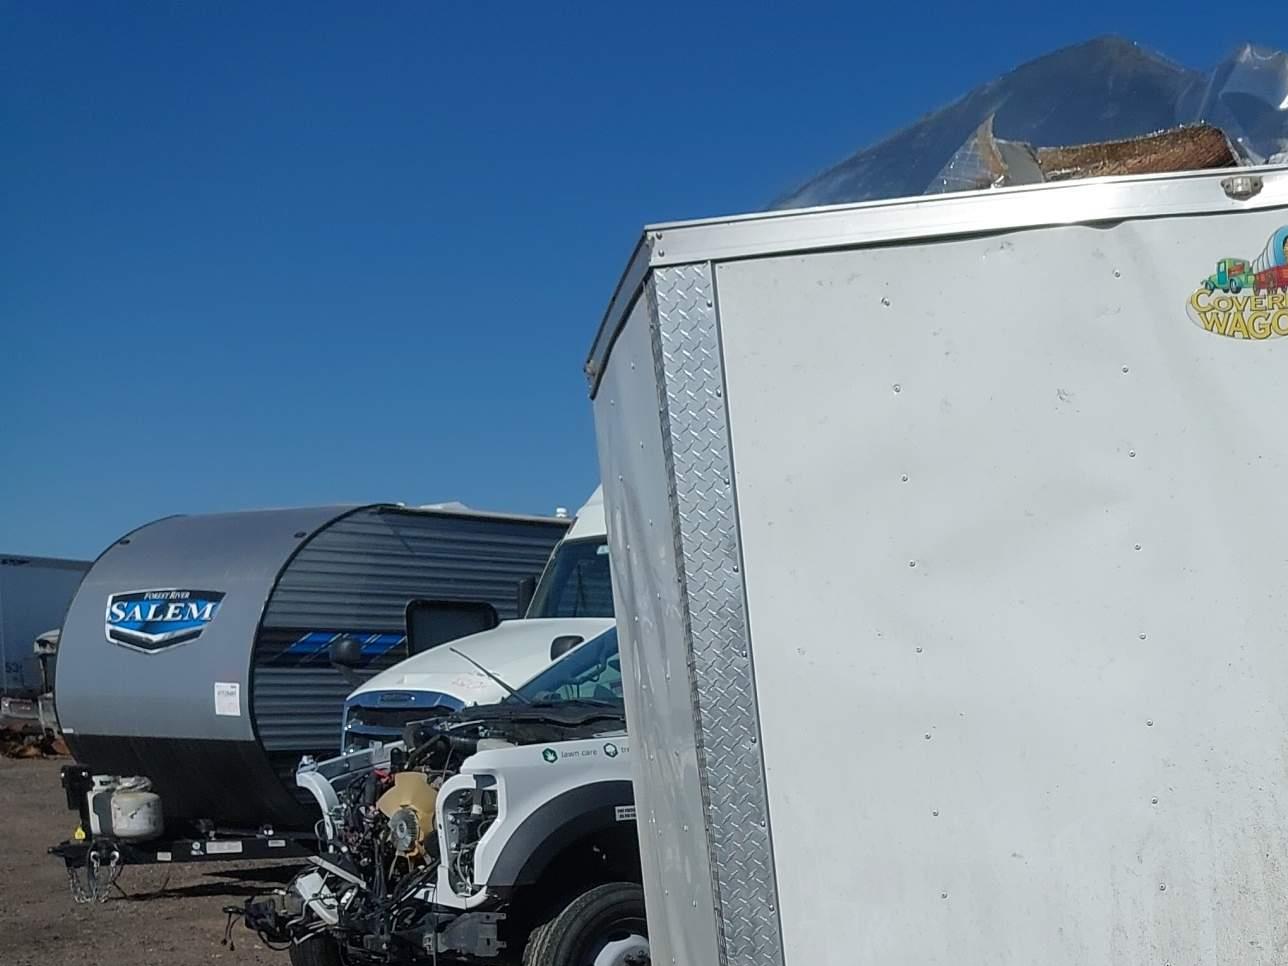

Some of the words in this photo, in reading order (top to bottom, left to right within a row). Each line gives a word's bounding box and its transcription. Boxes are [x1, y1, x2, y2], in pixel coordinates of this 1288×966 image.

[144, 591, 170, 600] FOREST
[169, 591, 190, 599] RIVER
[108, 600, 216, 622] SALEM
[561, 750, 580, 759] lawn
[581, 749, 598, 757] care
